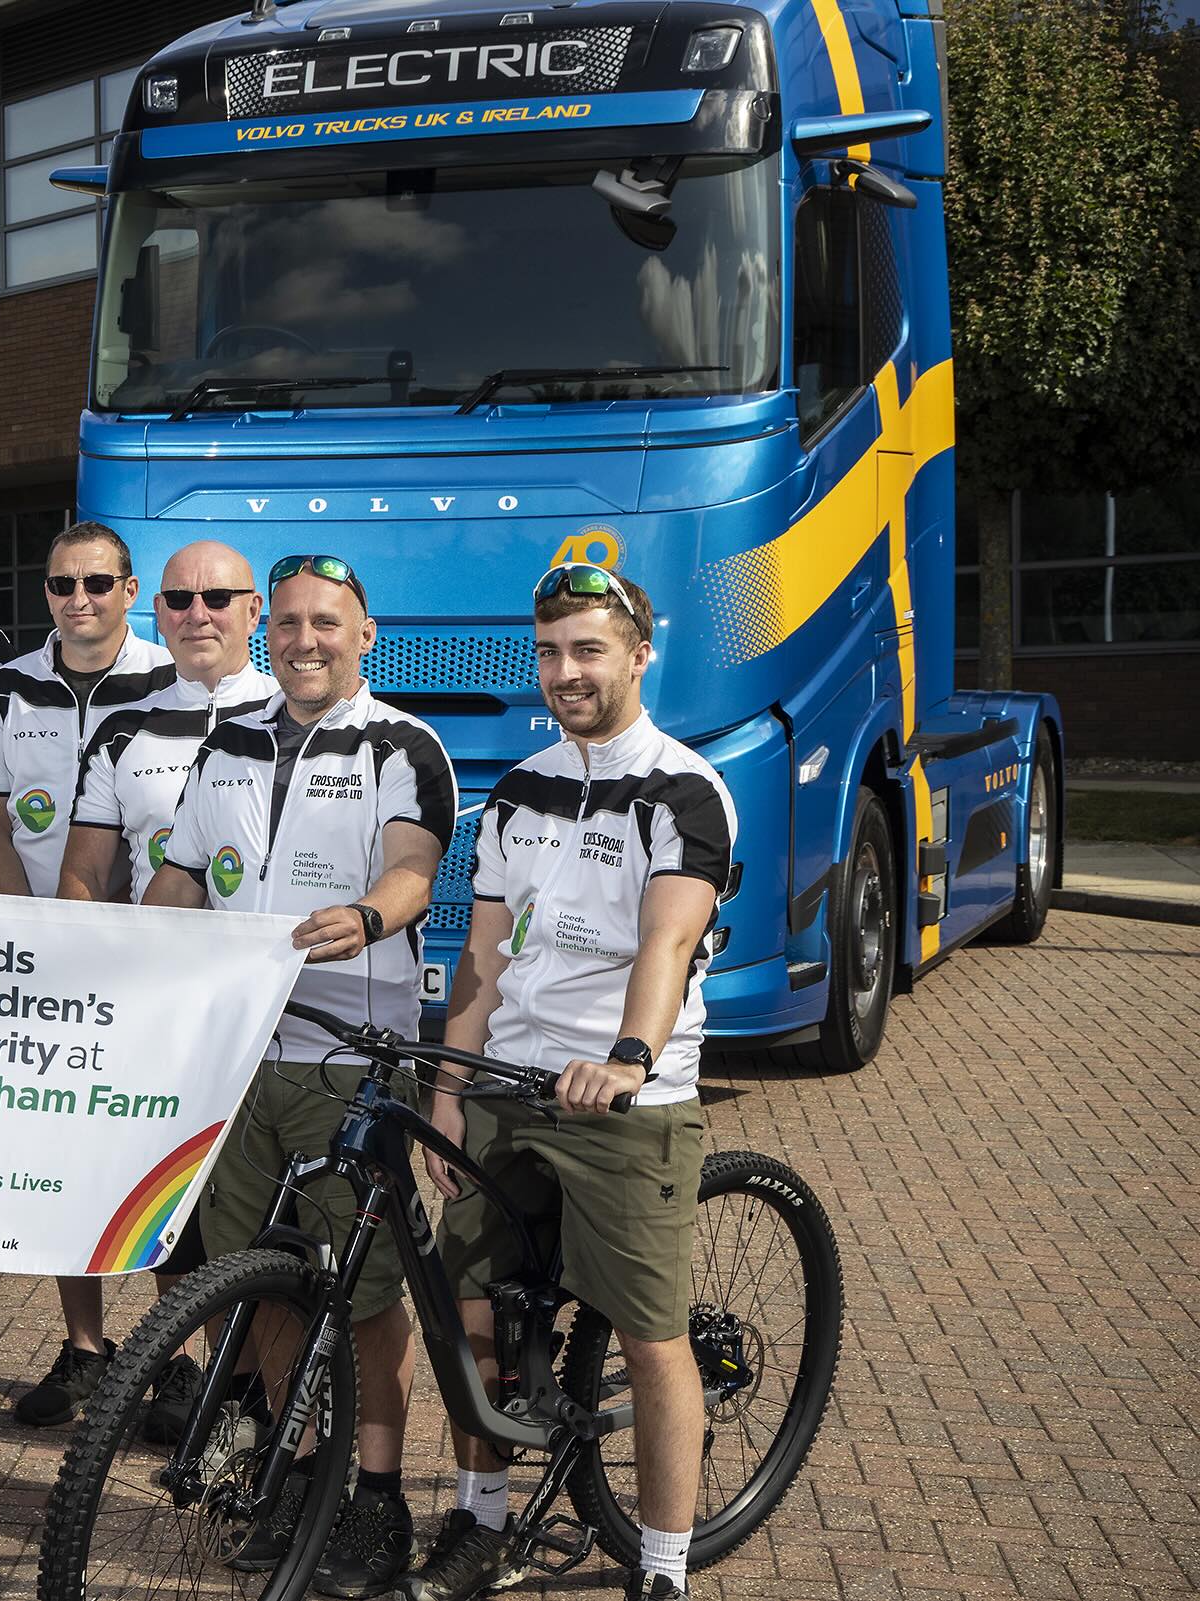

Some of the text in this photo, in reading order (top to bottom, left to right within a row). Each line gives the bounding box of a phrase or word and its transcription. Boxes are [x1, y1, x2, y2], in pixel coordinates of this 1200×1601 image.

[263, 40, 588, 98] ELECTRIC
[236, 103, 591, 142] VOLVO TRUCKS UK & IRELAND
[246, 495, 519, 514] VOLVO
[550, 530, 619, 570] 40
[13, 730, 58, 741] VOLVO
[133, 765, 190, 778] VOLVO
[985, 764, 1017, 792] VOLVO
[211, 778, 253, 789] VOLVO
[306, 788, 327, 798] TRUCK
[328, 789, 334, 798] &
[350, 789, 362, 800] LTD
[512, 835, 560, 848] VOVO
[295, 851, 318, 859] Leeds
[593, 849, 599, 860] &
[600, 852, 616, 867] BUS
[293, 860, 334, 871] Children's
[292, 869, 323, 880] Charity
[291, 879, 351, 891] Lineham Farm
[559, 911, 585, 924] Leeds
[557, 920, 601, 936] Children's
[556, 930, 588, 945] Charity
[555, 940, 618, 957] Lineham Farm
[67, 1041, 104, 1071] at
[87, 1084, 180, 1118] Farm
[9, 1172, 63, 1193] Lives
[745, 1175, 804, 1207] MAXXIS
